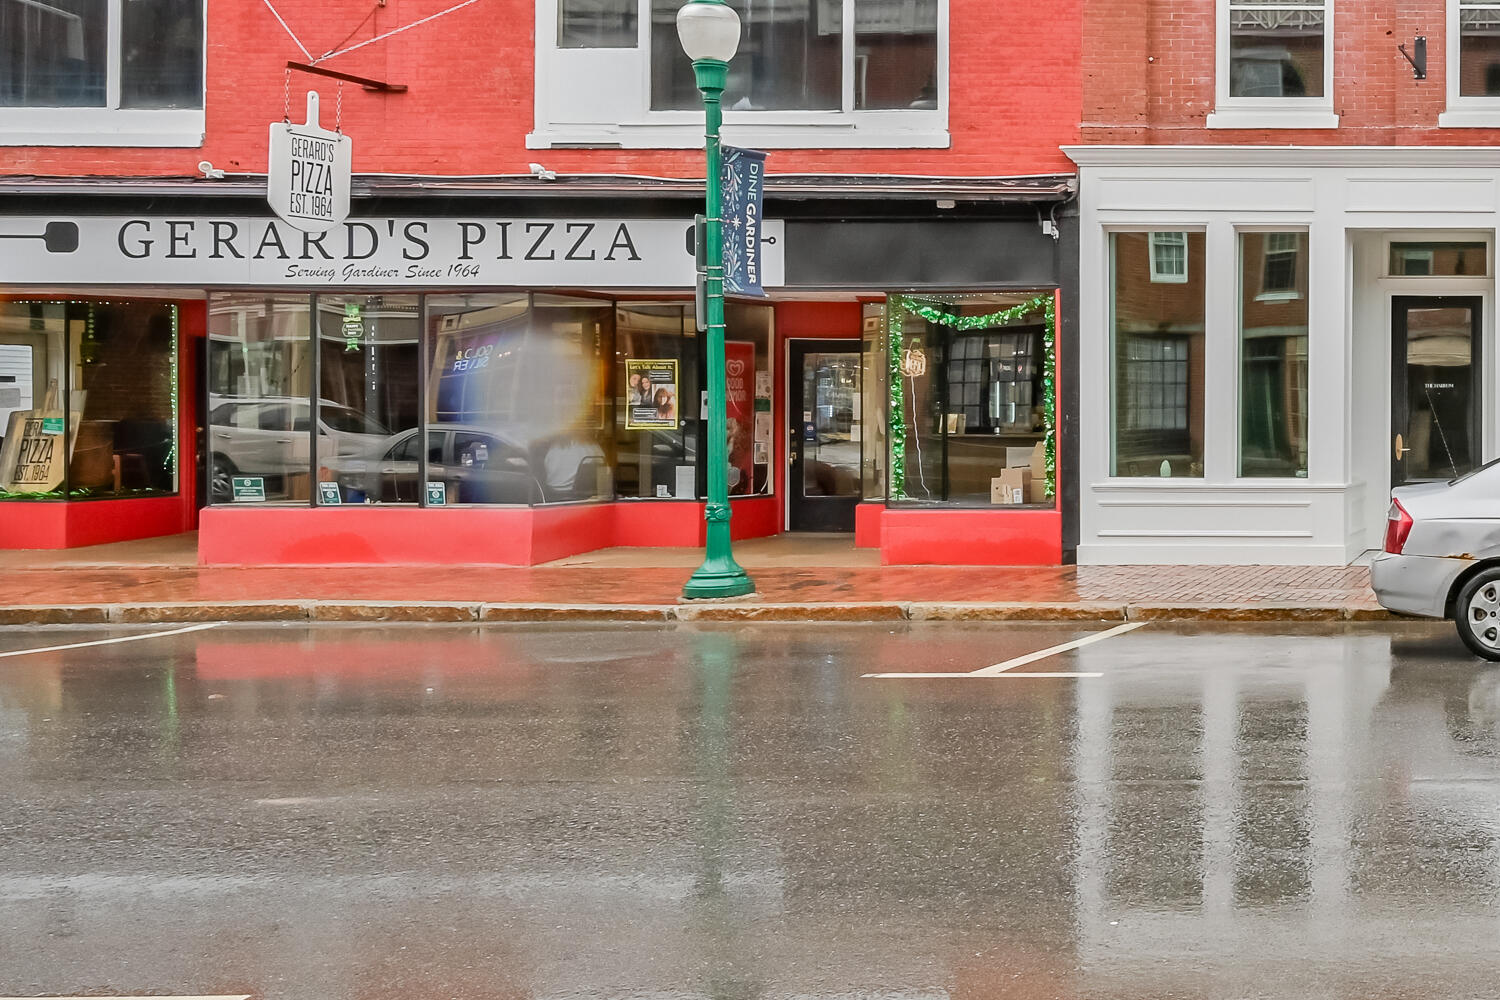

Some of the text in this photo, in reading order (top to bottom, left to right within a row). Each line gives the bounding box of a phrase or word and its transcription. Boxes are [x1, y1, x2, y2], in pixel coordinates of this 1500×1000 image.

[291, 137, 334, 163] GERARD'S
[291, 159, 333, 196] PIZZA
[290, 193, 332, 217] EST. 1964
[745, 163, 759, 284] DINE GARDINER
[118, 219, 642, 261] GERARD'S PIZZA
[285, 263, 480, 282] Serving Gardiner Since 1964
[18, 438, 54, 464] PIZZA
[31, 465, 50, 481] 1964
